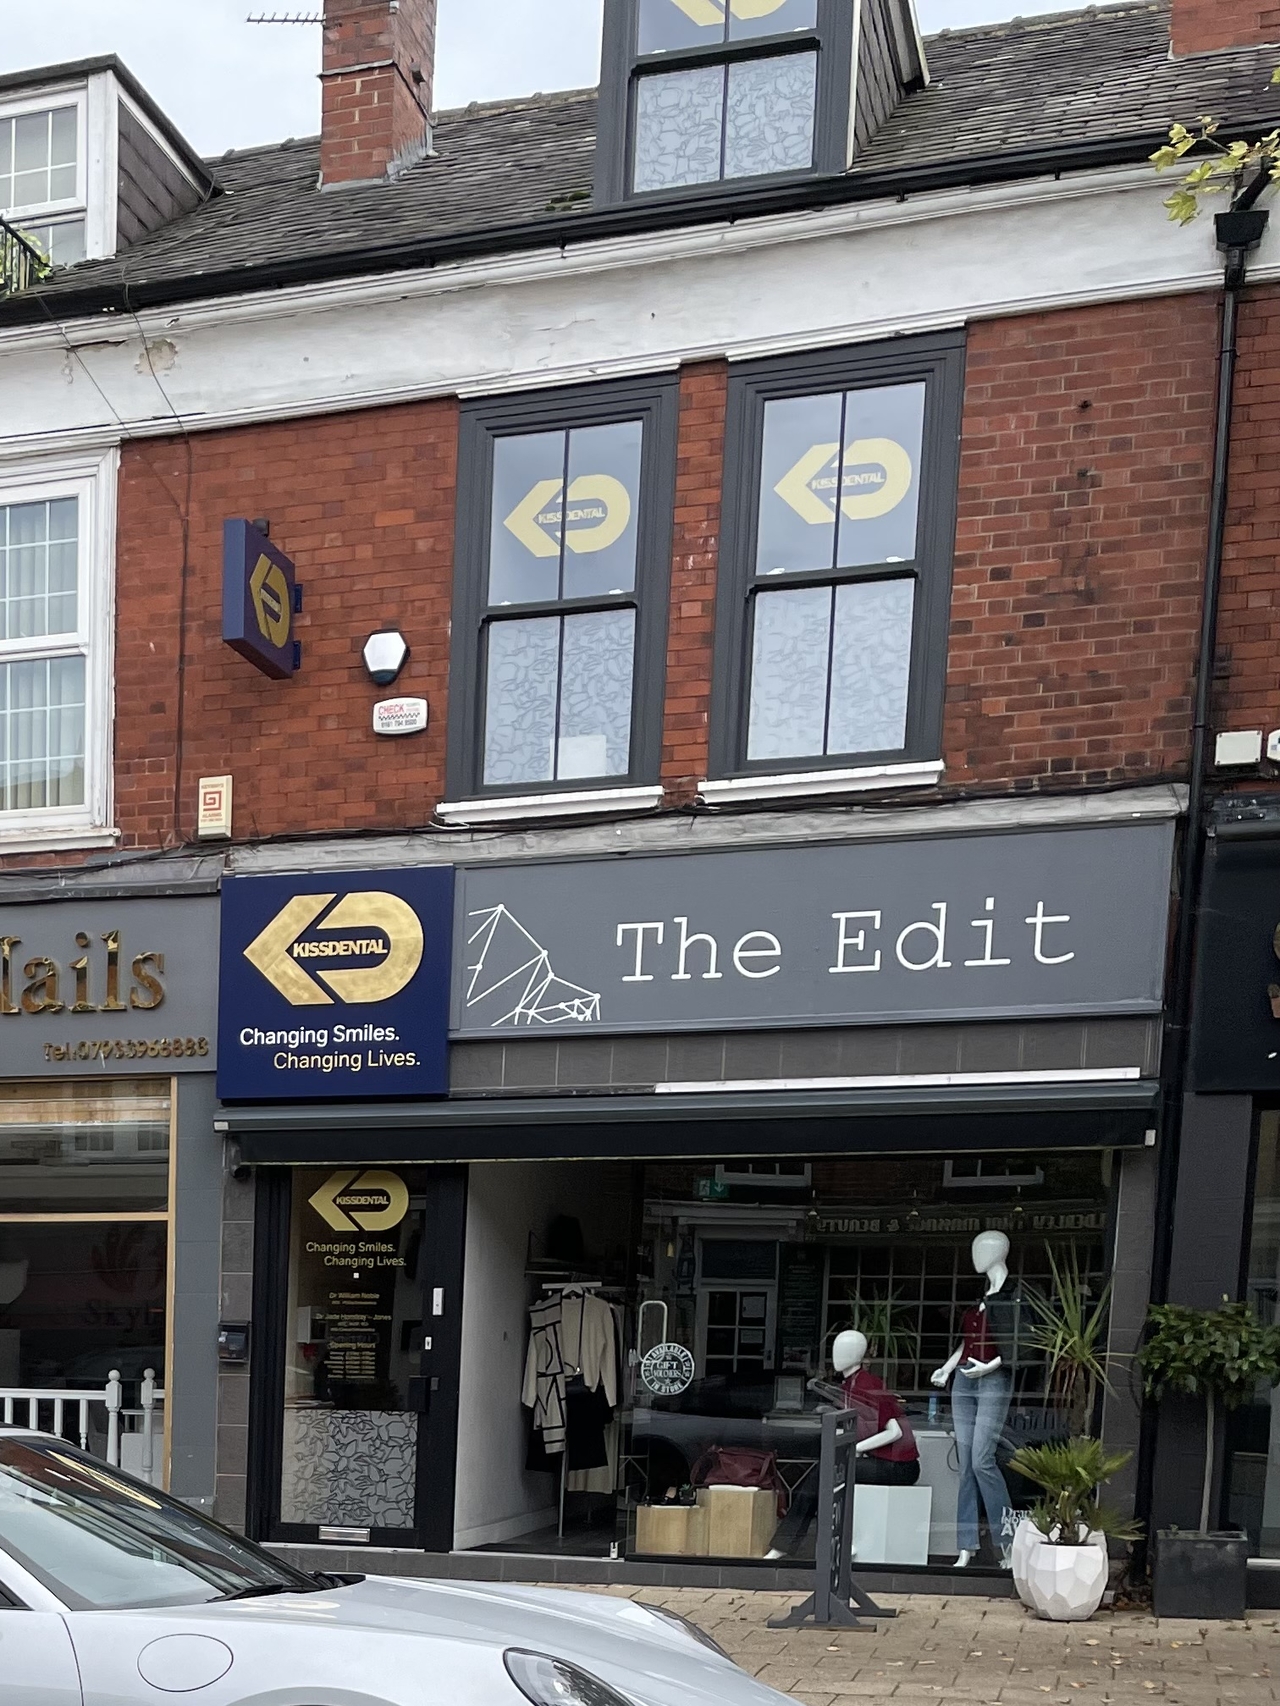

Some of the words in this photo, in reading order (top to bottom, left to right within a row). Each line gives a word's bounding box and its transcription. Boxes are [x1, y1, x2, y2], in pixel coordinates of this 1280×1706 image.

[378, 704, 404, 716] CHECK
[616, 917, 782, 982] The
[829, 897, 1075, 972] Edit
[293, 939, 388, 957] KISSDENTAL
[240, 1026, 329, 1048] Changing
[333, 1023, 400, 1042] Smiles.
[273, 1051, 362, 1072] Changing
[368, 1050, 421, 1067] Lives.
[336, 1196, 389, 1205] KISSDENTAL
[306, 1242, 355, 1254] Changing
[358, 1242, 396, 1252] Smiles.
[324, 1256, 374, 1268] Changing
[377, 1256, 406, 1266] Lives.
